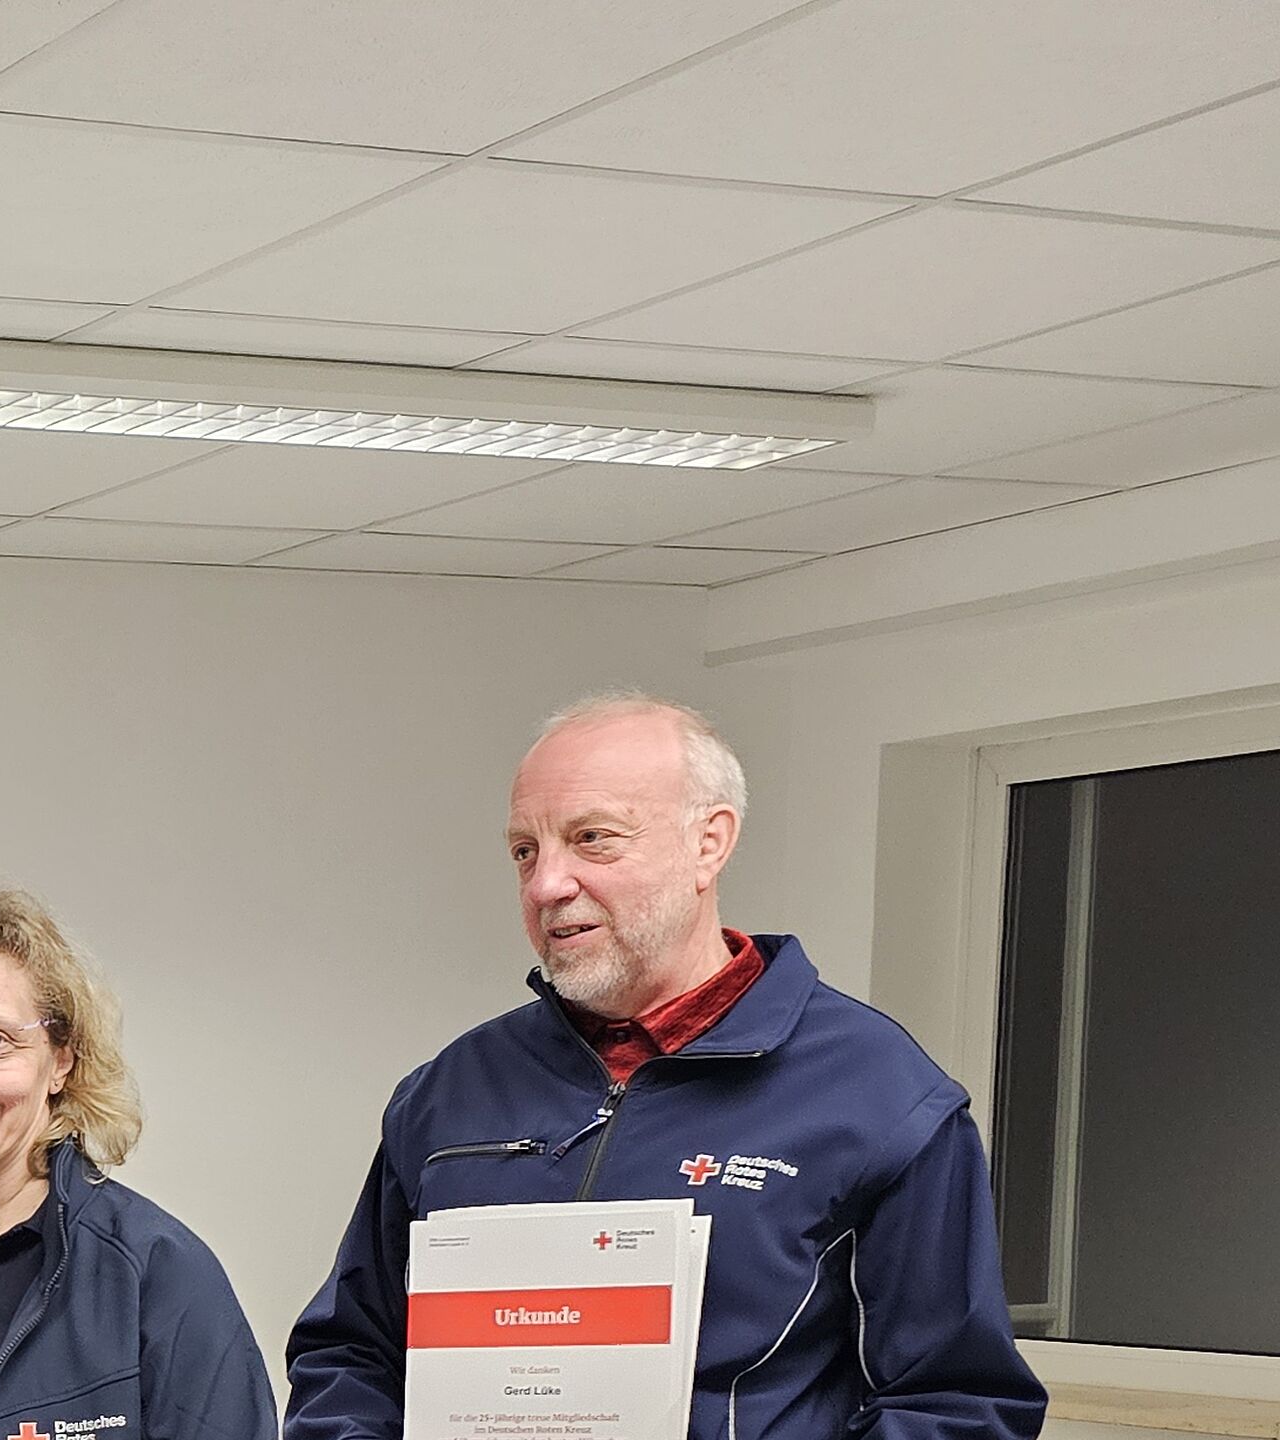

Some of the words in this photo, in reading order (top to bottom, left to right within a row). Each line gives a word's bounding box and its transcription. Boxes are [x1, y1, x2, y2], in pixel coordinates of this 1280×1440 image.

[721, 1175, 764, 1190] Kreuz
[495, 1307, 581, 1325] Urkunde
[504, 1387, 530, 1395] Gerd
[534, 1386, 561, 1395] Lüke
[55, 1415, 126, 1433] Deutsches
[553, 1414, 619, 1423] Mitgliedschaft
